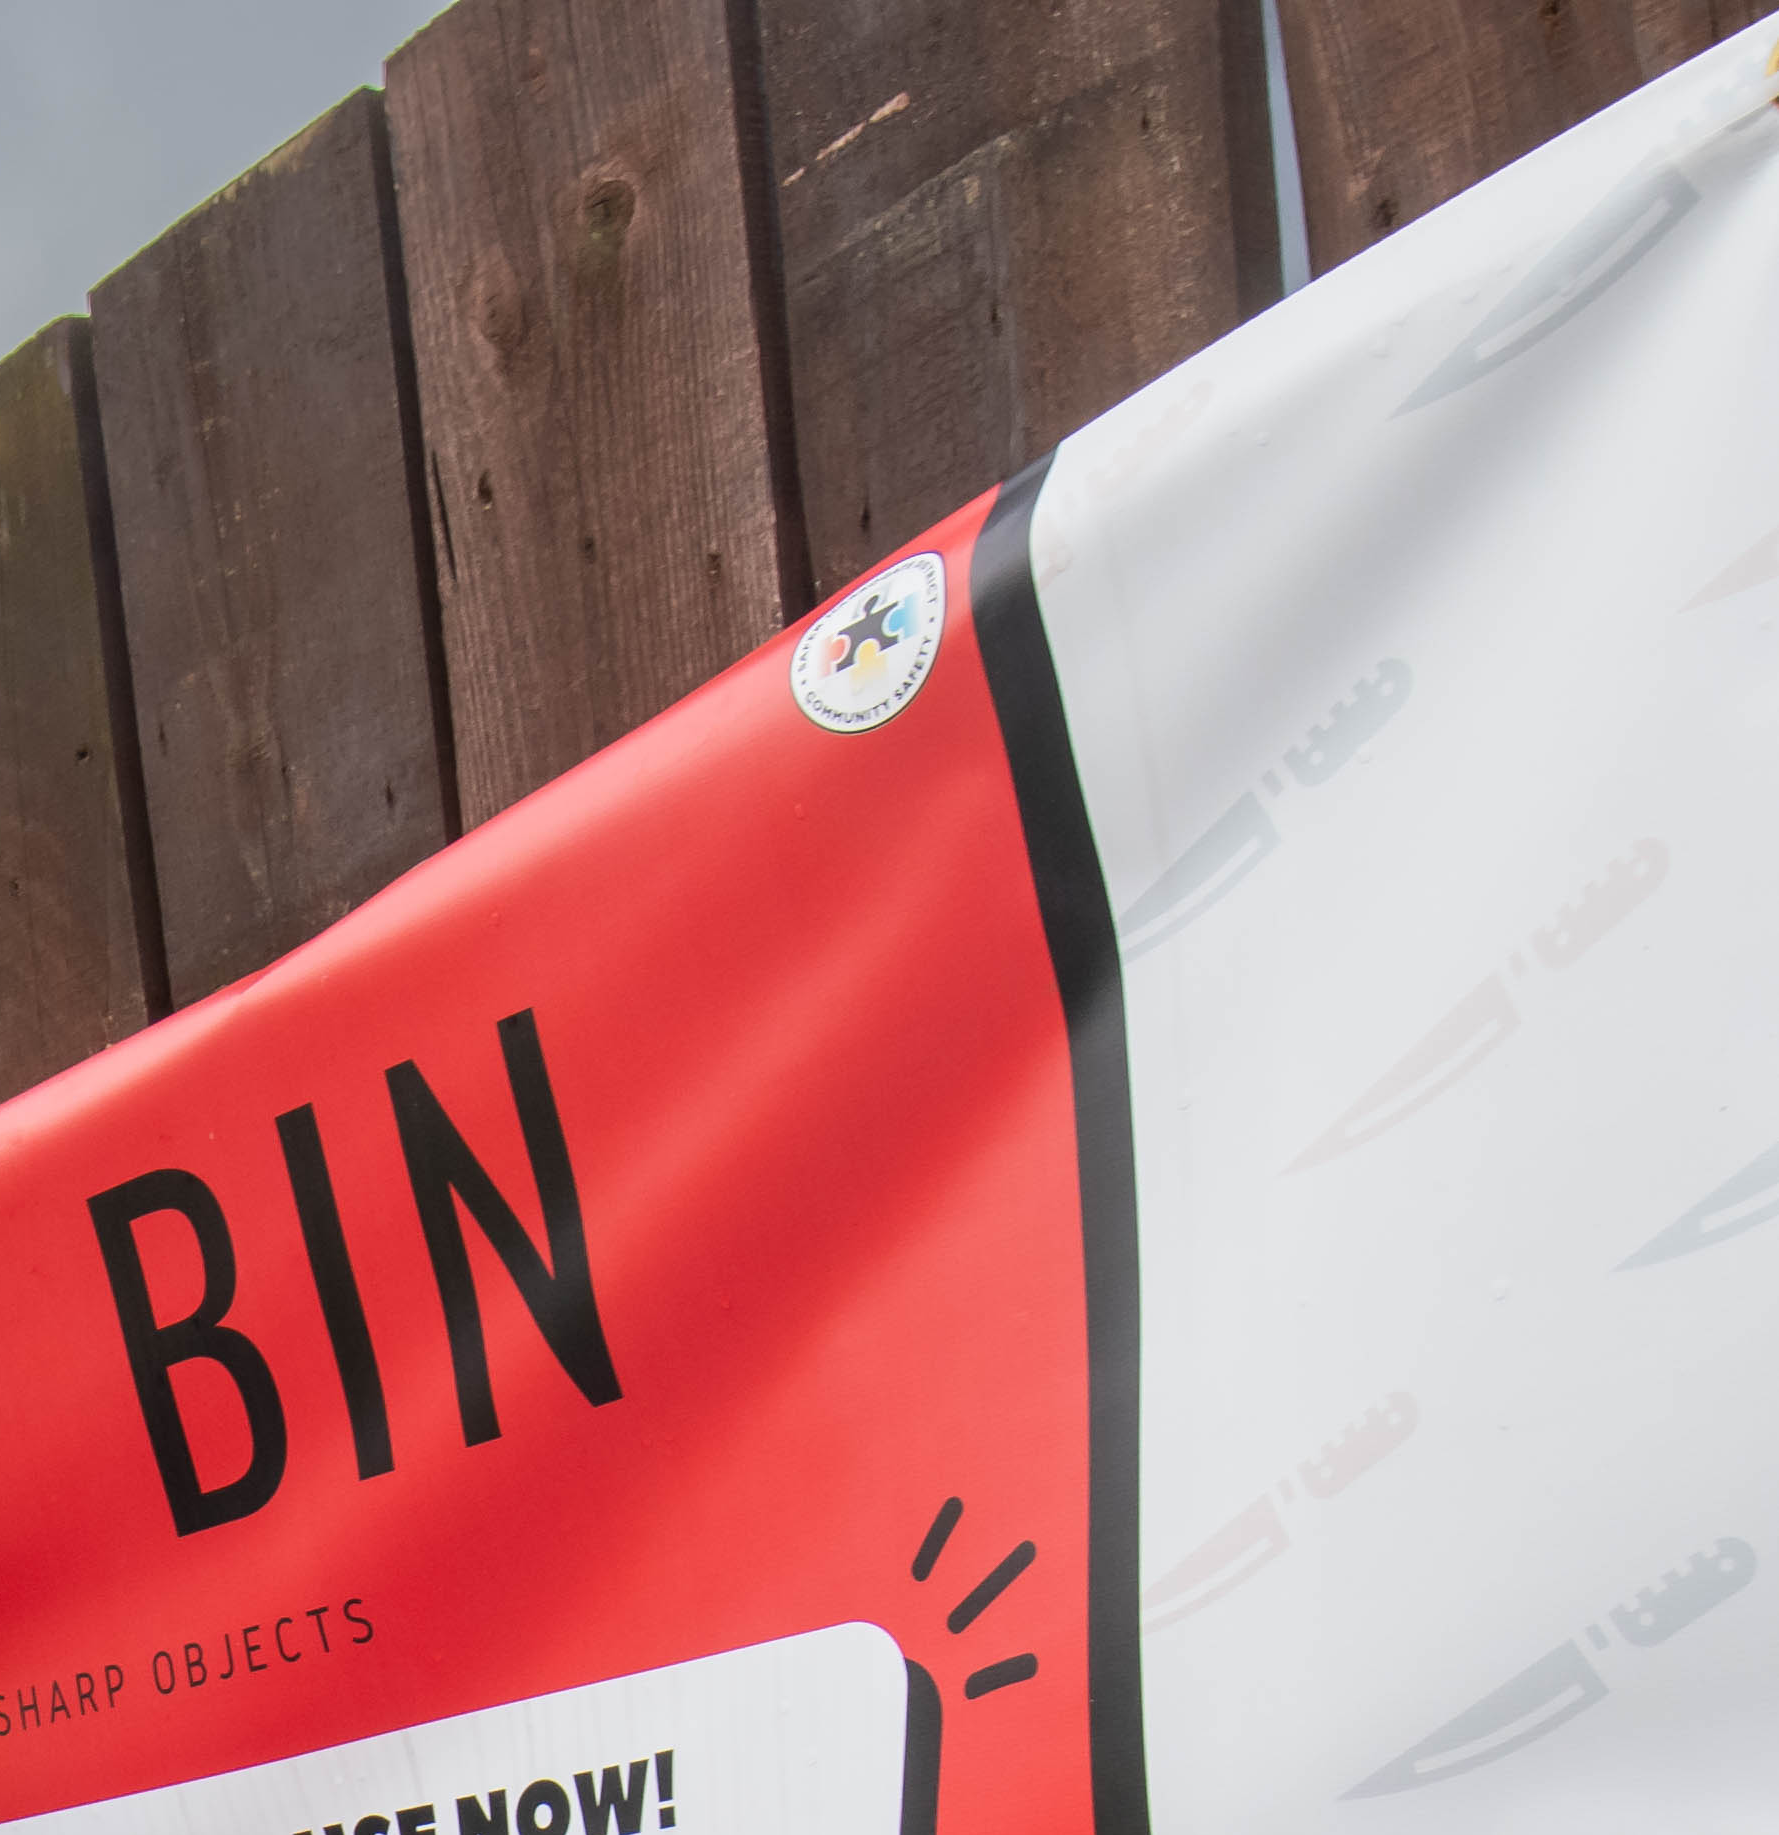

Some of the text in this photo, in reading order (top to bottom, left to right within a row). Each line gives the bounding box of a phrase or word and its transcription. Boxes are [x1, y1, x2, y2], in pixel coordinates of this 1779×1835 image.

[805, 637, 933, 723] COMMUNITY SAFETY
[84, 1007, 624, 1540] BIN
[152, 1596, 376, 1697] OBJECTS
